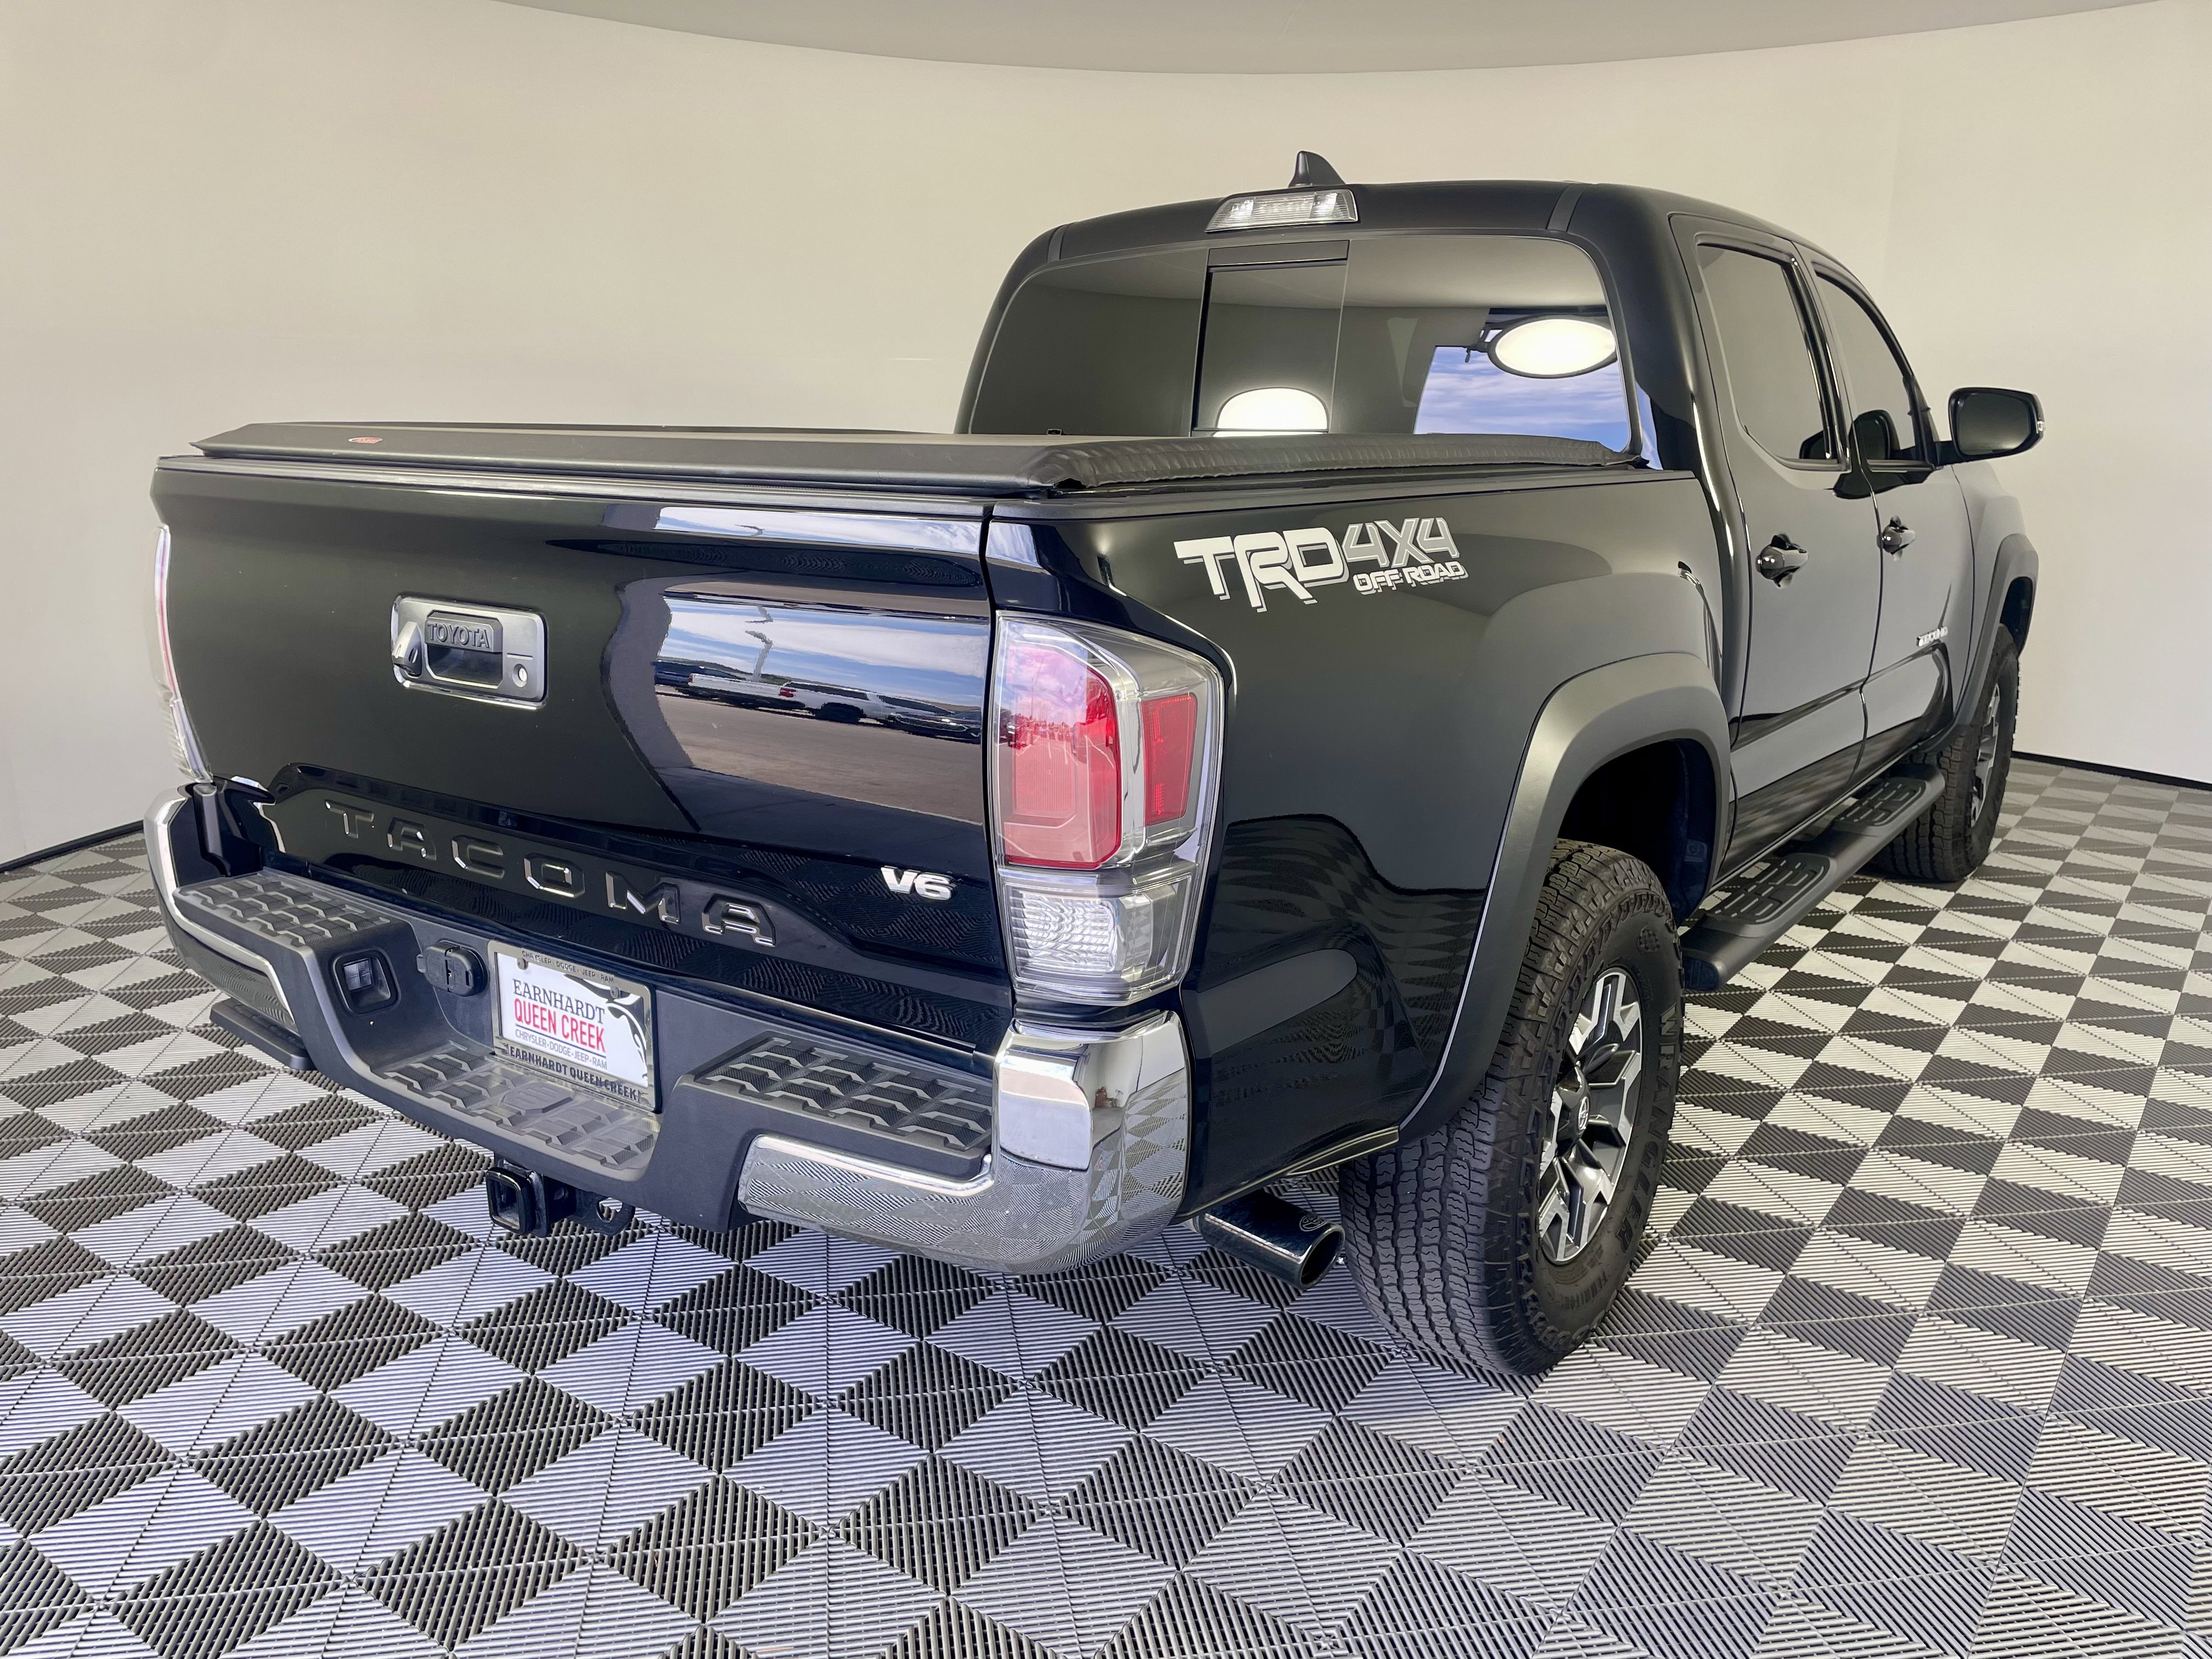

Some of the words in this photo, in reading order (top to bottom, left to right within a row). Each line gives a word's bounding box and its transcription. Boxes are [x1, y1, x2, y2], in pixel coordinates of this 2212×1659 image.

[1173, 527, 1349, 612] TRD
[1353, 569, 1404, 595] OFF
[1402, 561, 1469, 587] ROAD
[427, 622, 490, 648] TOYOTA
[325, 799, 776, 947] TACOMA
[881, 865, 957, 900] V6
[522, 951, 551, 965] CHRYSLER
[556, 961, 576, 972] DODGE
[581, 968, 596, 977] JEEP
[600, 974, 614, 984] RAM
[512, 978, 605, 1024] EARNHARDT
[514, 998, 556, 1035] QUEEN
[561, 1014, 606, 1053] CREEK
[510, 1046, 567, 1075] EARNHARDT
[569, 1066, 602, 1087] QUEEN
[604, 1079, 636, 1100] CREEK
[1616, 1002, 1677, 1253] WRANGLER
